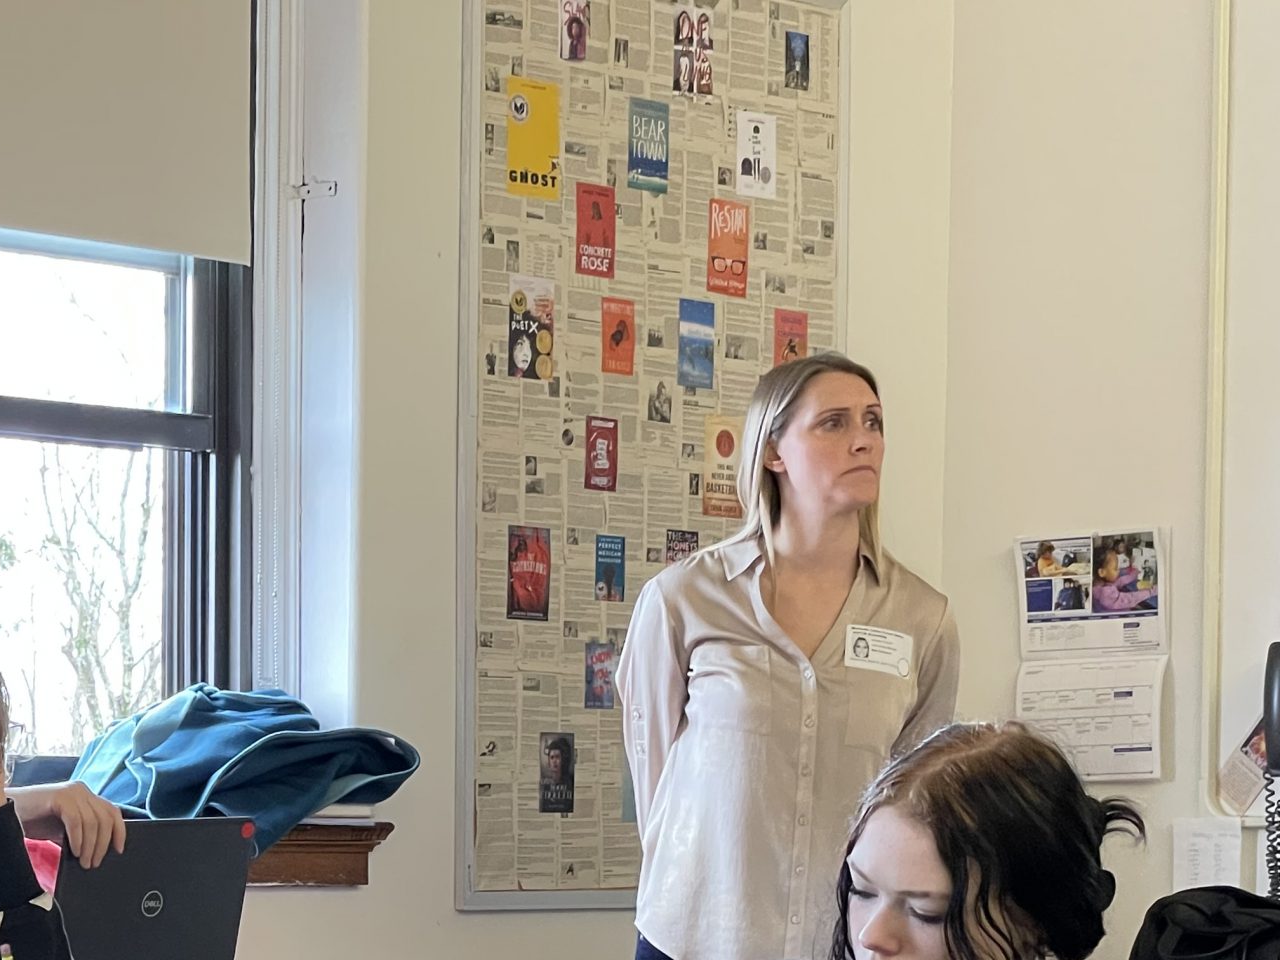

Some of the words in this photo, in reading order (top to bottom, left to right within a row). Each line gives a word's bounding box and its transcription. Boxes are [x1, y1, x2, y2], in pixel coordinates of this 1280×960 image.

[632, 115, 666, 141] BEAR
[632, 138, 667, 162] TOWN
[509, 170, 557, 188] GHOST
[580, 244, 612, 259] CONCRETE
[581, 257, 609, 272] ROSE
[511, 321, 528, 330] POET
[529, 321, 539, 334] X
[144, 900, 161, 908] DELL
